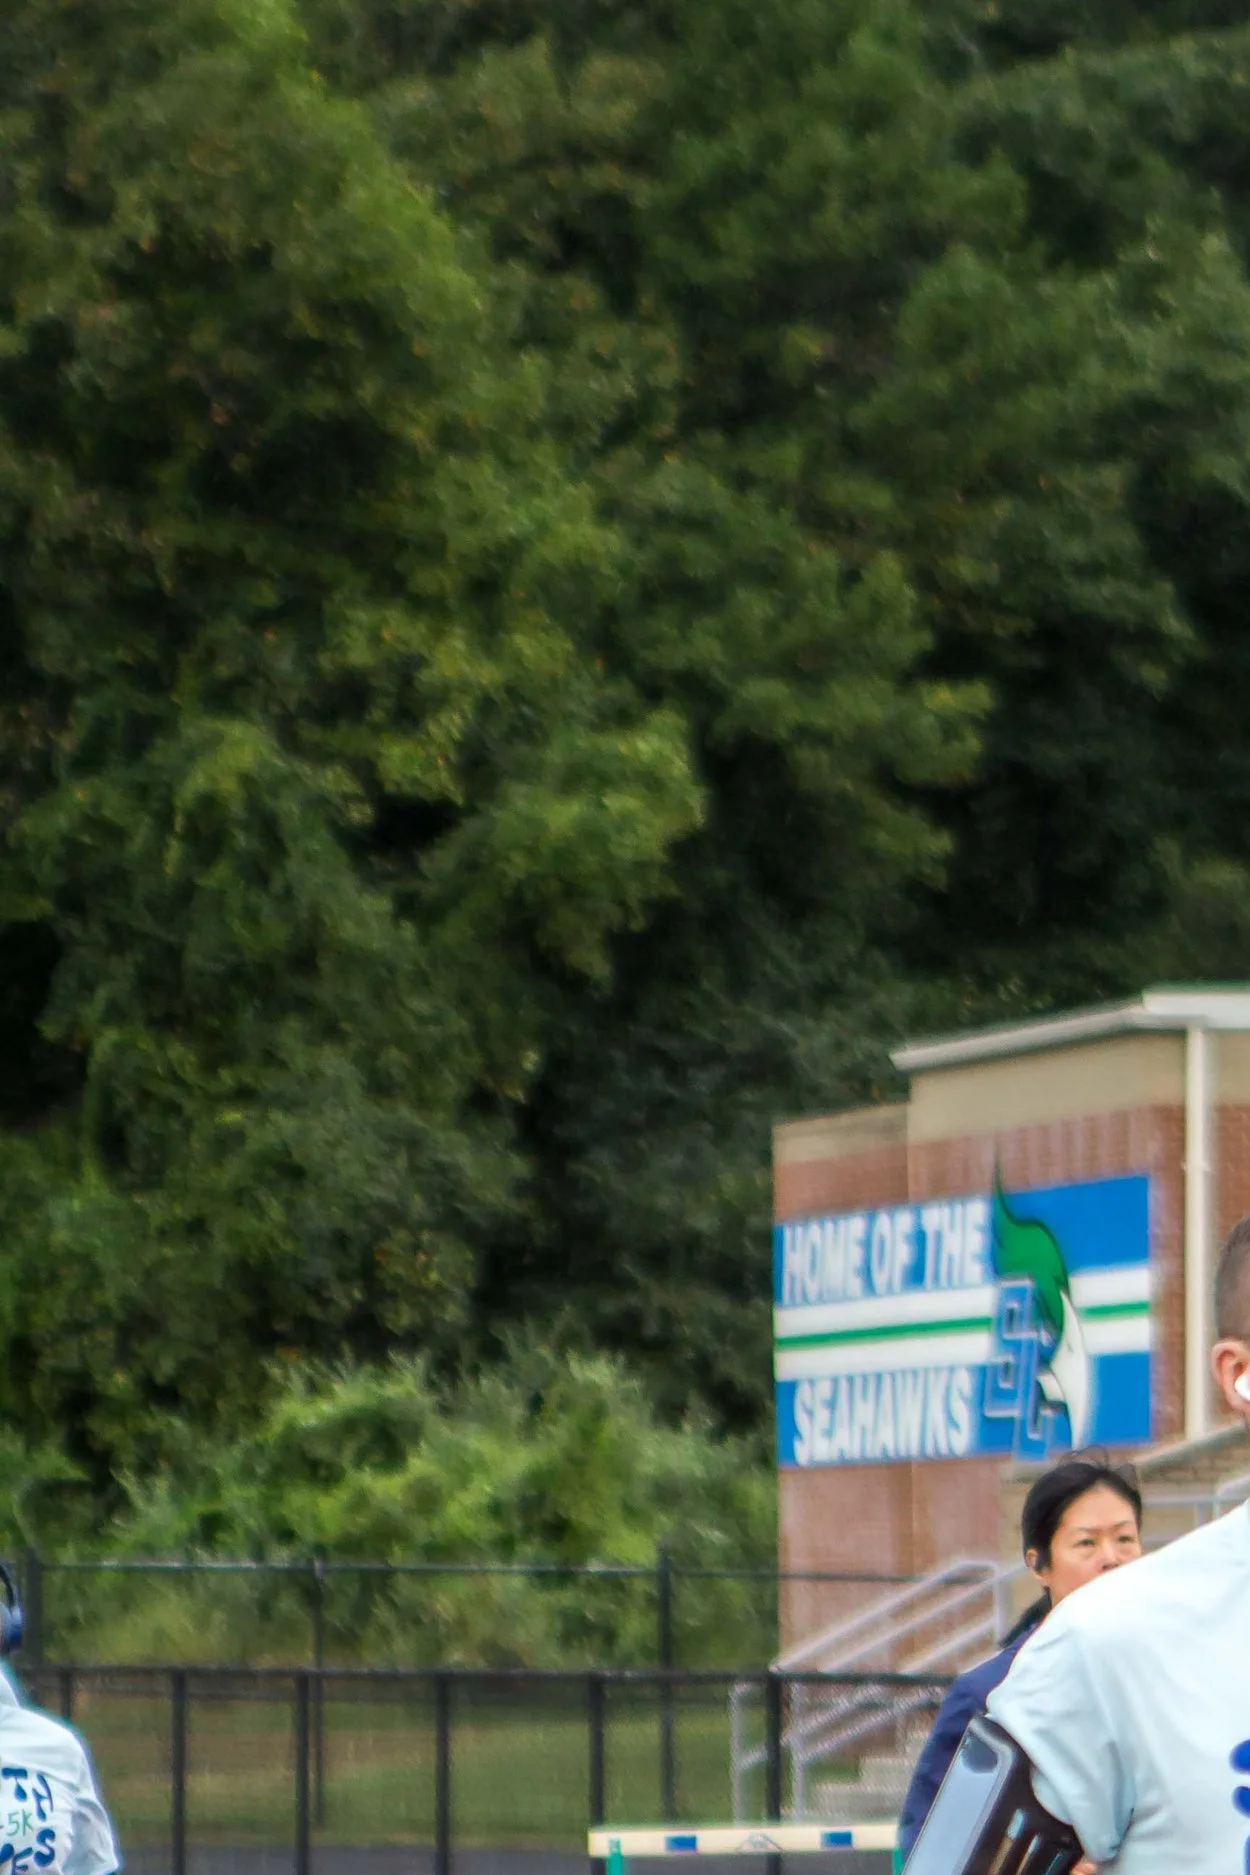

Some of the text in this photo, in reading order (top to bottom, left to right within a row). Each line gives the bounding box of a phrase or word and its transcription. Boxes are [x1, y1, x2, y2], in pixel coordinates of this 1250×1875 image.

[783, 1199, 986, 1305] HOME OF THE
[794, 1367, 973, 1466] SEAHAWKS
